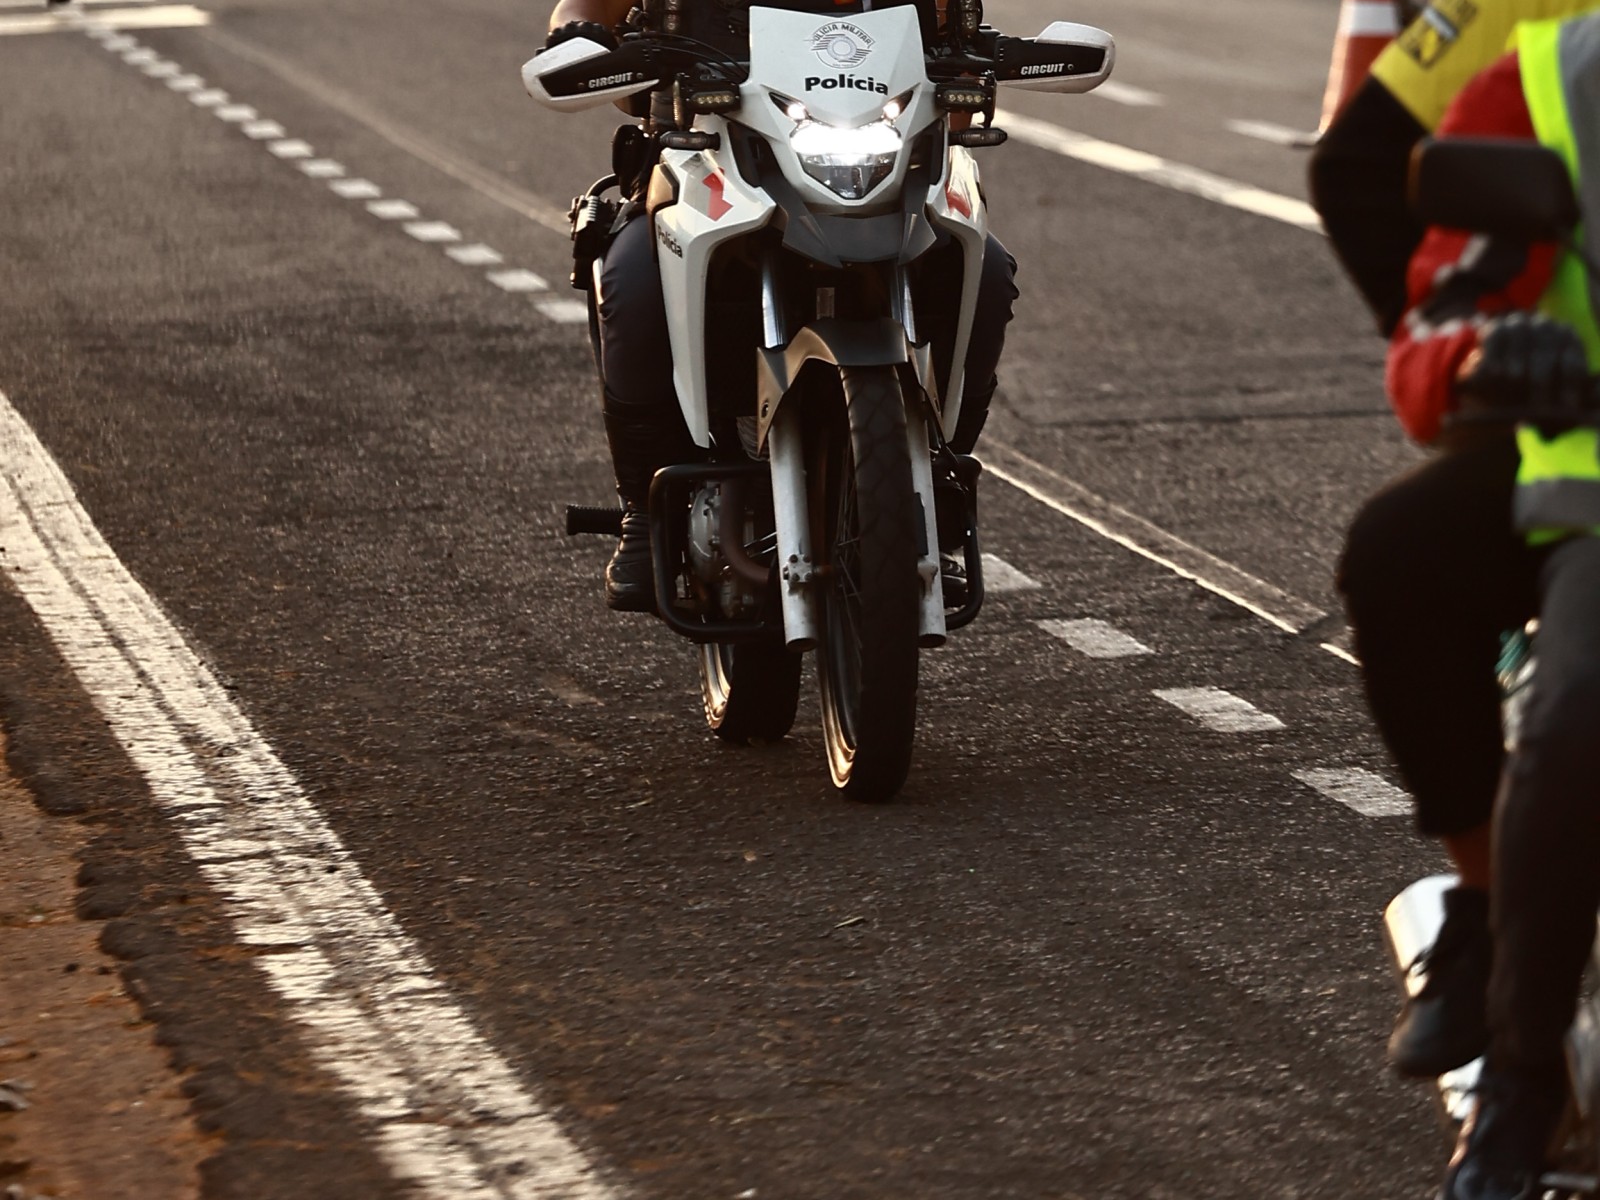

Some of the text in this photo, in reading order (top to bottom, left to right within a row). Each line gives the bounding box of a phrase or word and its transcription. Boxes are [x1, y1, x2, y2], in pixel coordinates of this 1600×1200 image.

[841, 24, 872, 44] MILITAR
[1020, 63, 1065, 76] CIRCUIT
[588, 71, 633, 89] CIRCUIT
[805, 74, 888, 95] Polícia
